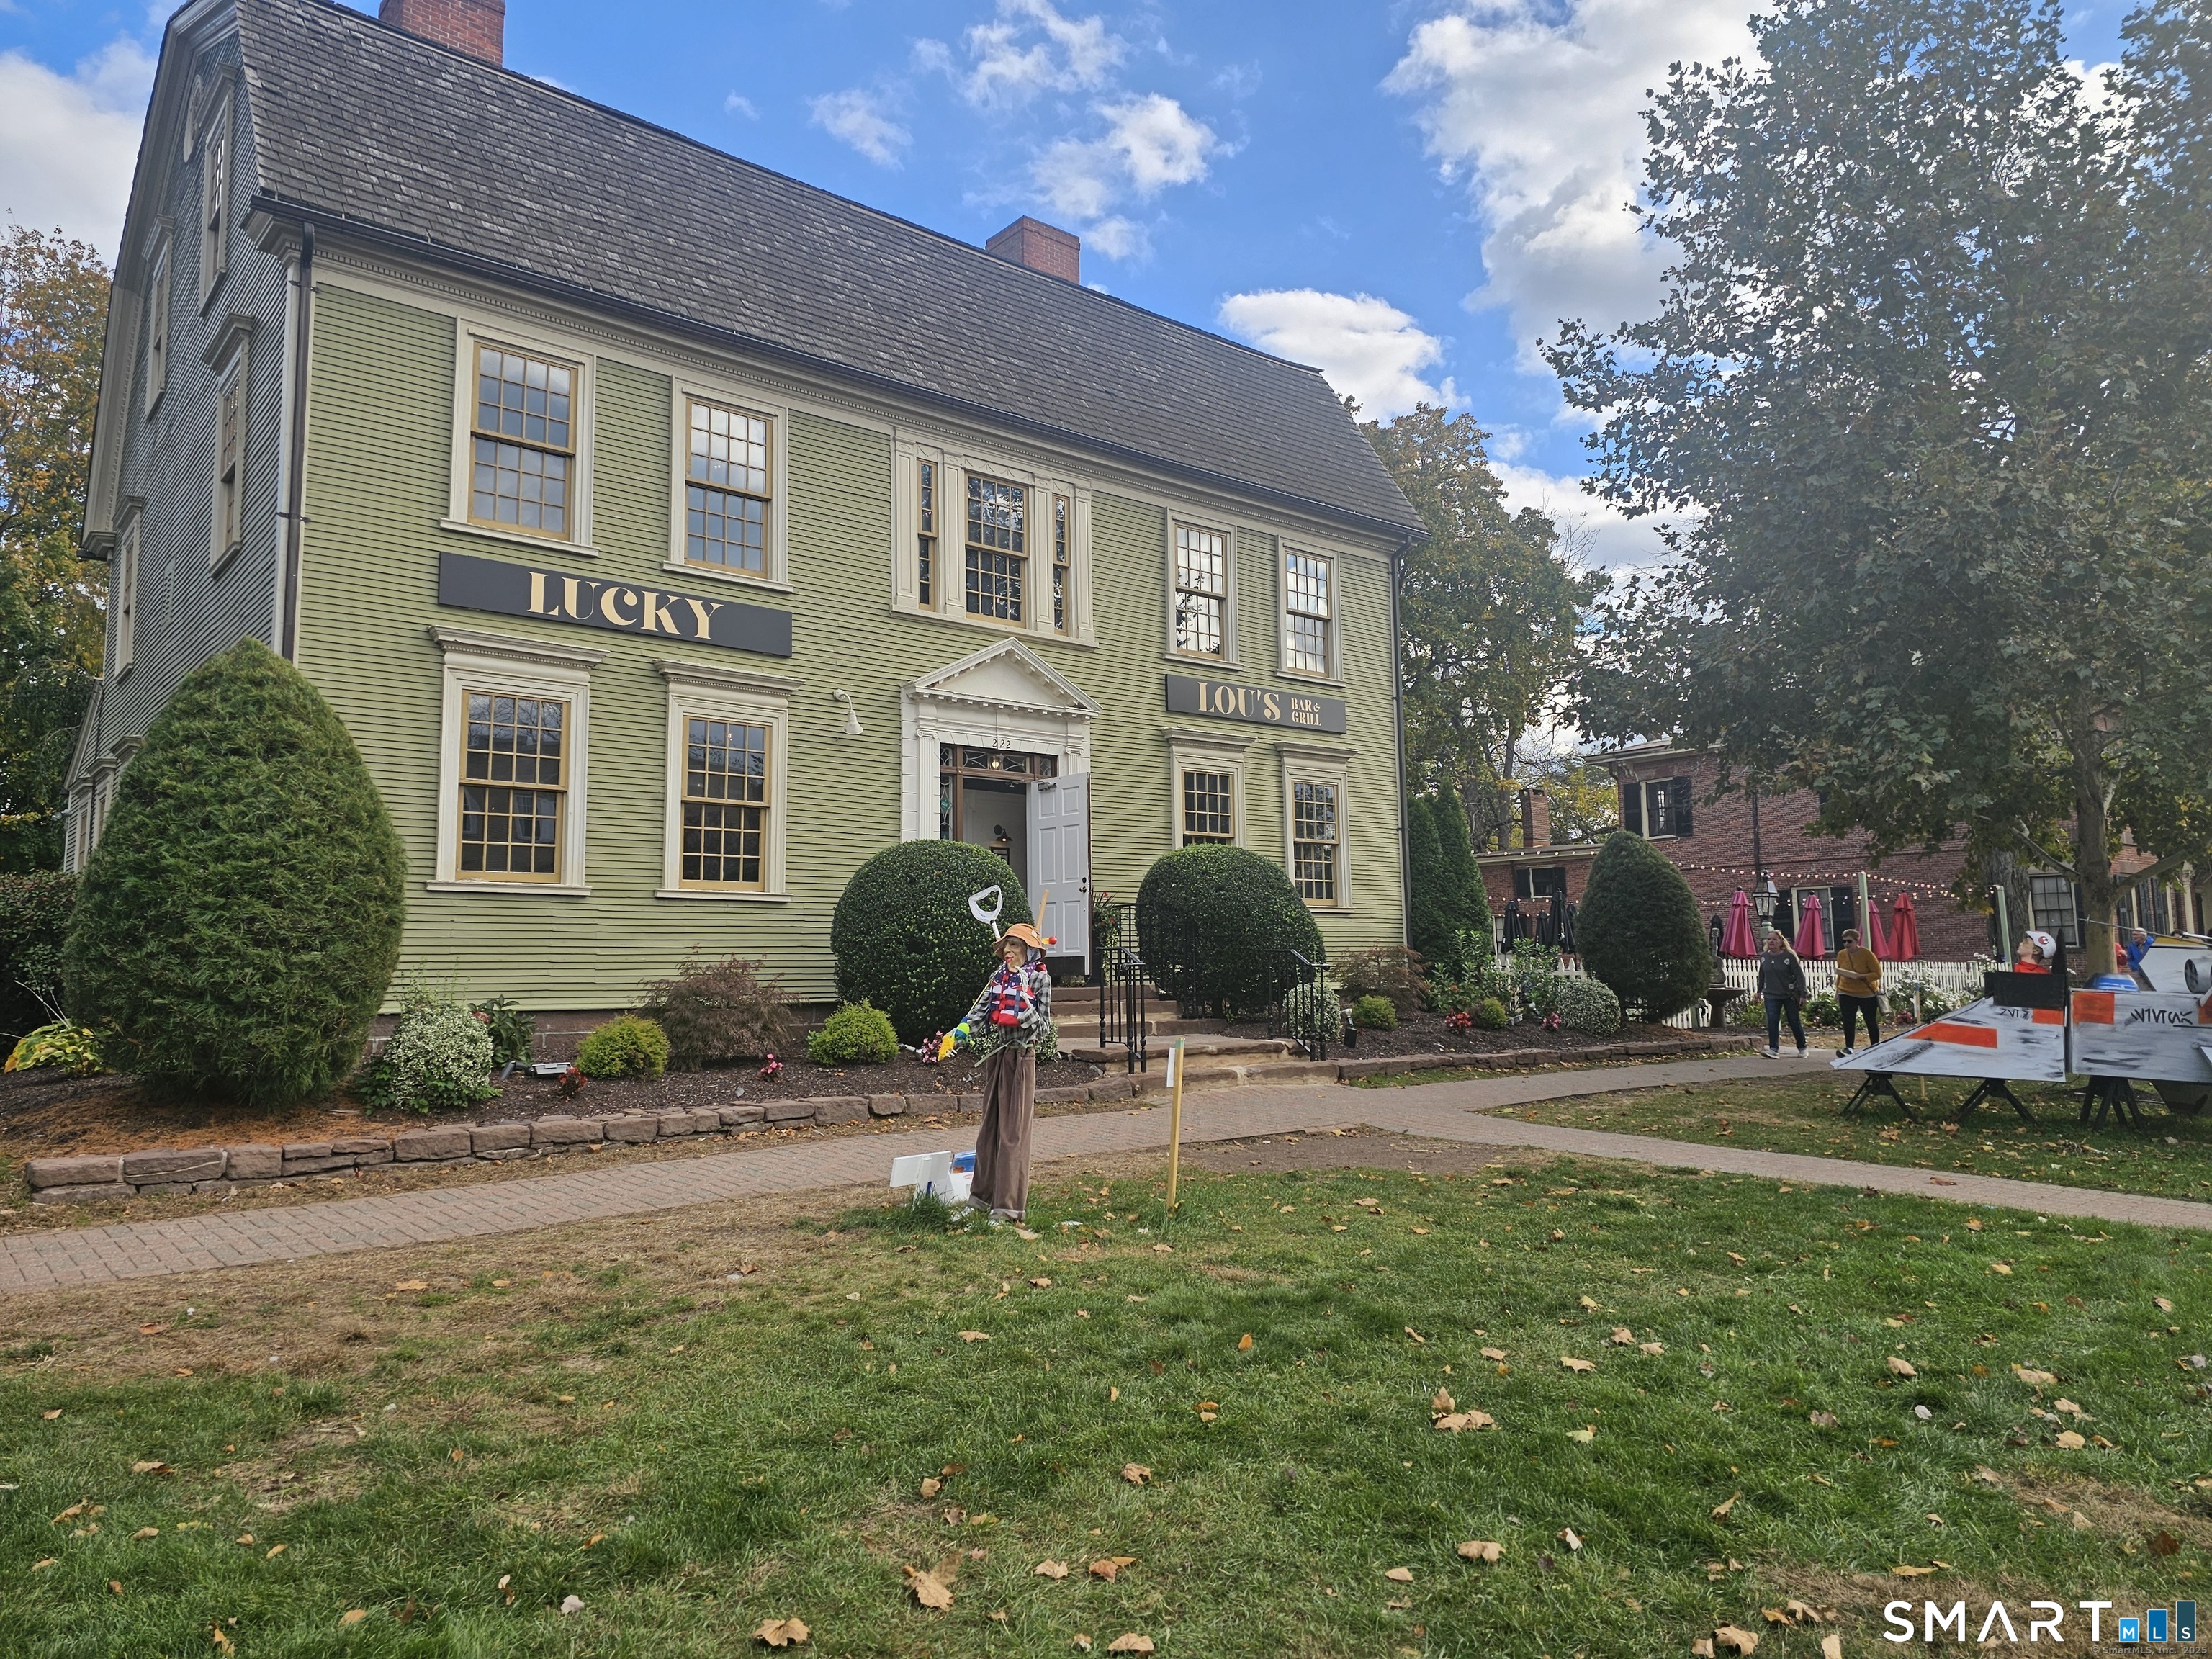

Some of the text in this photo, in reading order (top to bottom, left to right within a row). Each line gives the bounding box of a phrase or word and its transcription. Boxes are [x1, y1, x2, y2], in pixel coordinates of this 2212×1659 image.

[527, 571, 724, 640] LUCKY
[1197, 681, 1281, 721] LOU'S
[1290, 697, 1321, 713] BAR &
[1291, 711, 1321, 727] GRILL
[992, 738, 1011, 749] 222
